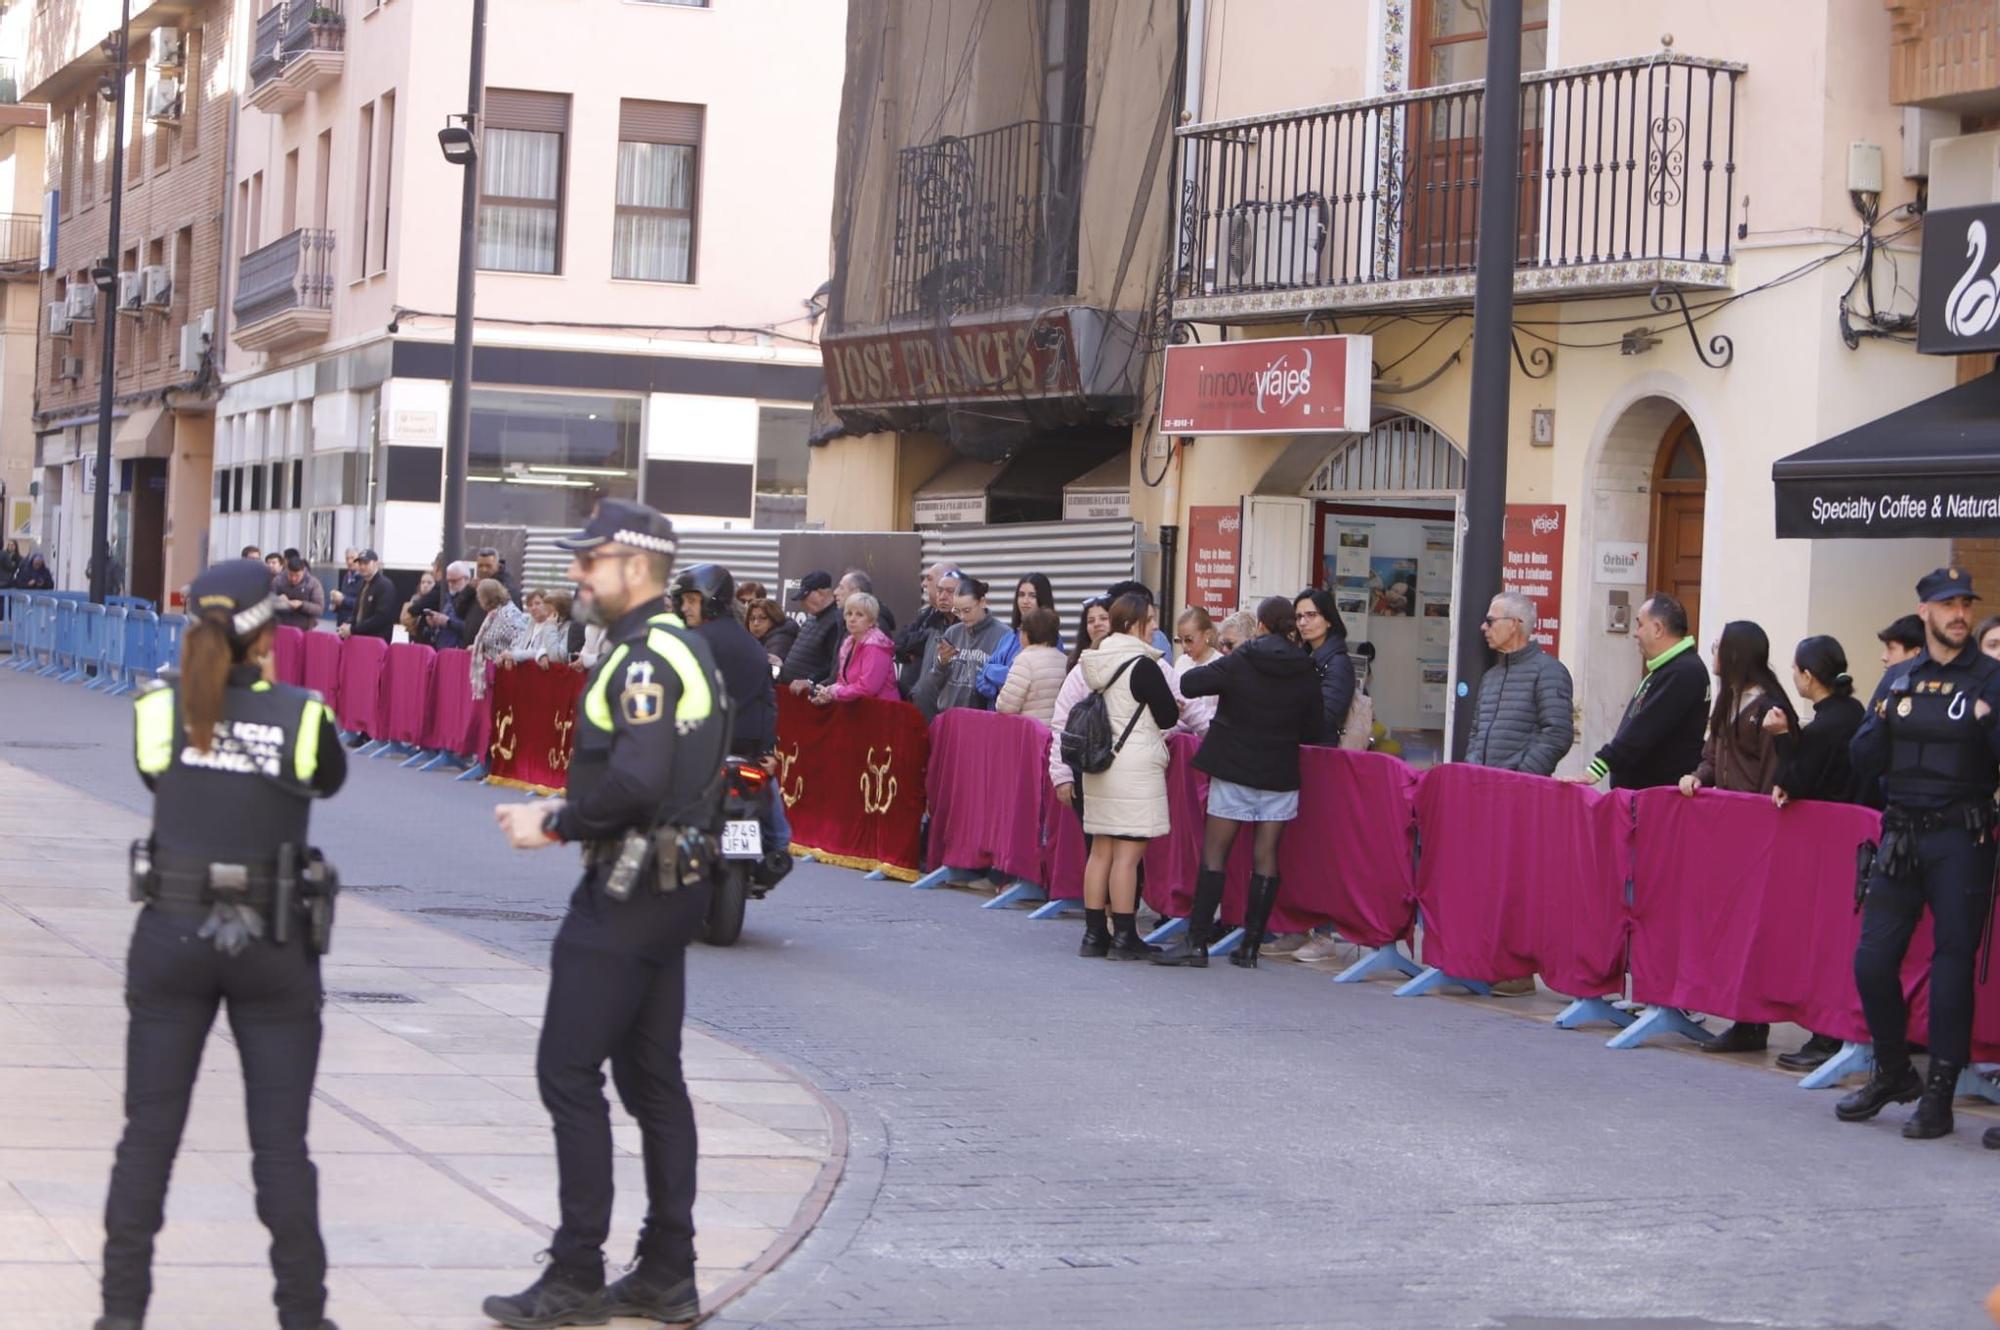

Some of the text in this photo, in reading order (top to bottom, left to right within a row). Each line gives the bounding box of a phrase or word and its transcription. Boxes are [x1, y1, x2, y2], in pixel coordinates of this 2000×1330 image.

[833, 329, 1036, 401] JOSE FRANCES
[1812, 494, 2000, 525] Specialty Coffee & Natural
[1603, 552, 1634, 566] Órbita
